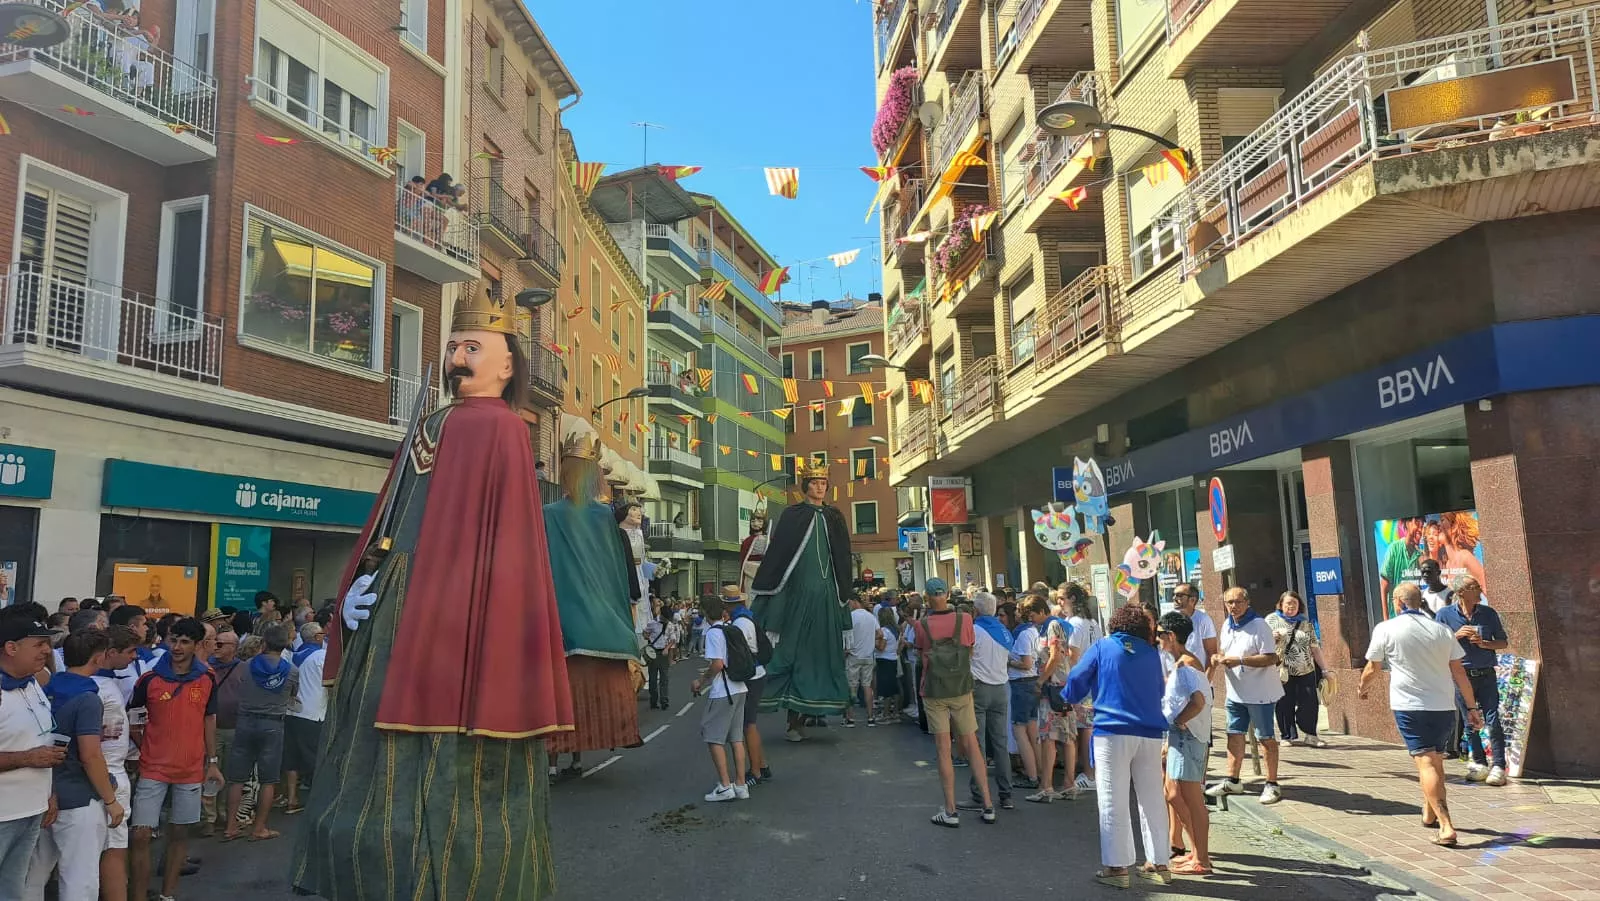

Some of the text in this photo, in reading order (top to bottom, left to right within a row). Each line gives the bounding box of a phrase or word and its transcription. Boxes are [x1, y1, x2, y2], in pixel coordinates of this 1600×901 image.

[1377, 354, 1455, 408] BBVA
[1209, 420, 1254, 457] BBVA
[1058, 480, 1073, 489] BB
[1106, 460, 1135, 487] BBVA
[261, 489, 321, 512] cajamar
[1315, 569, 1337, 583] BBVA
